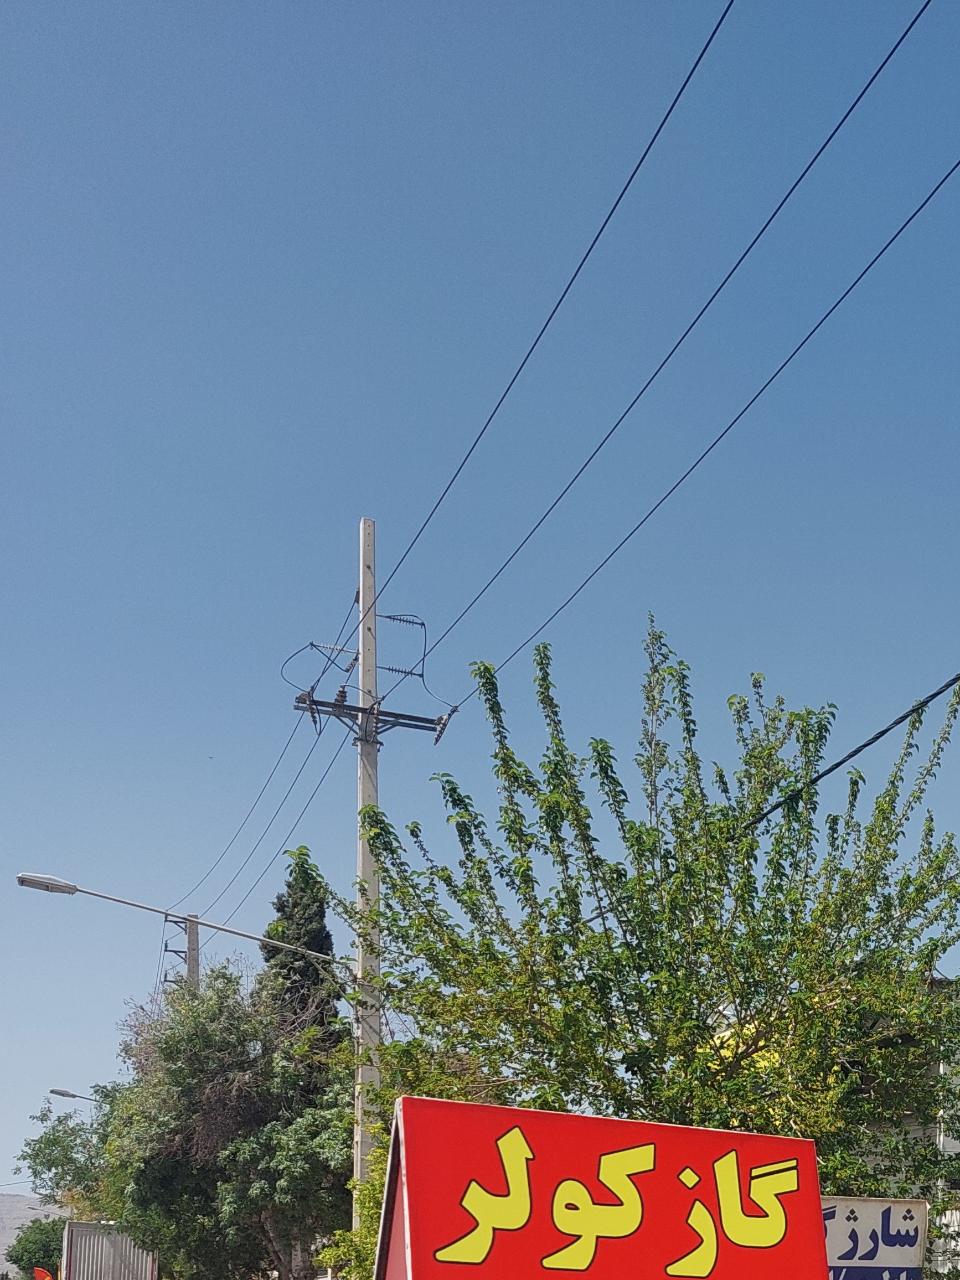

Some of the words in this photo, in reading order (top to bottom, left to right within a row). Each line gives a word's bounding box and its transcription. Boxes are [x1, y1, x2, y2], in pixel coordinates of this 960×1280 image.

[433, 1125, 656, 1272] کولر
[664, 1149, 800, 1279] گاز
[837, 1205, 919, 1261] شارژ
